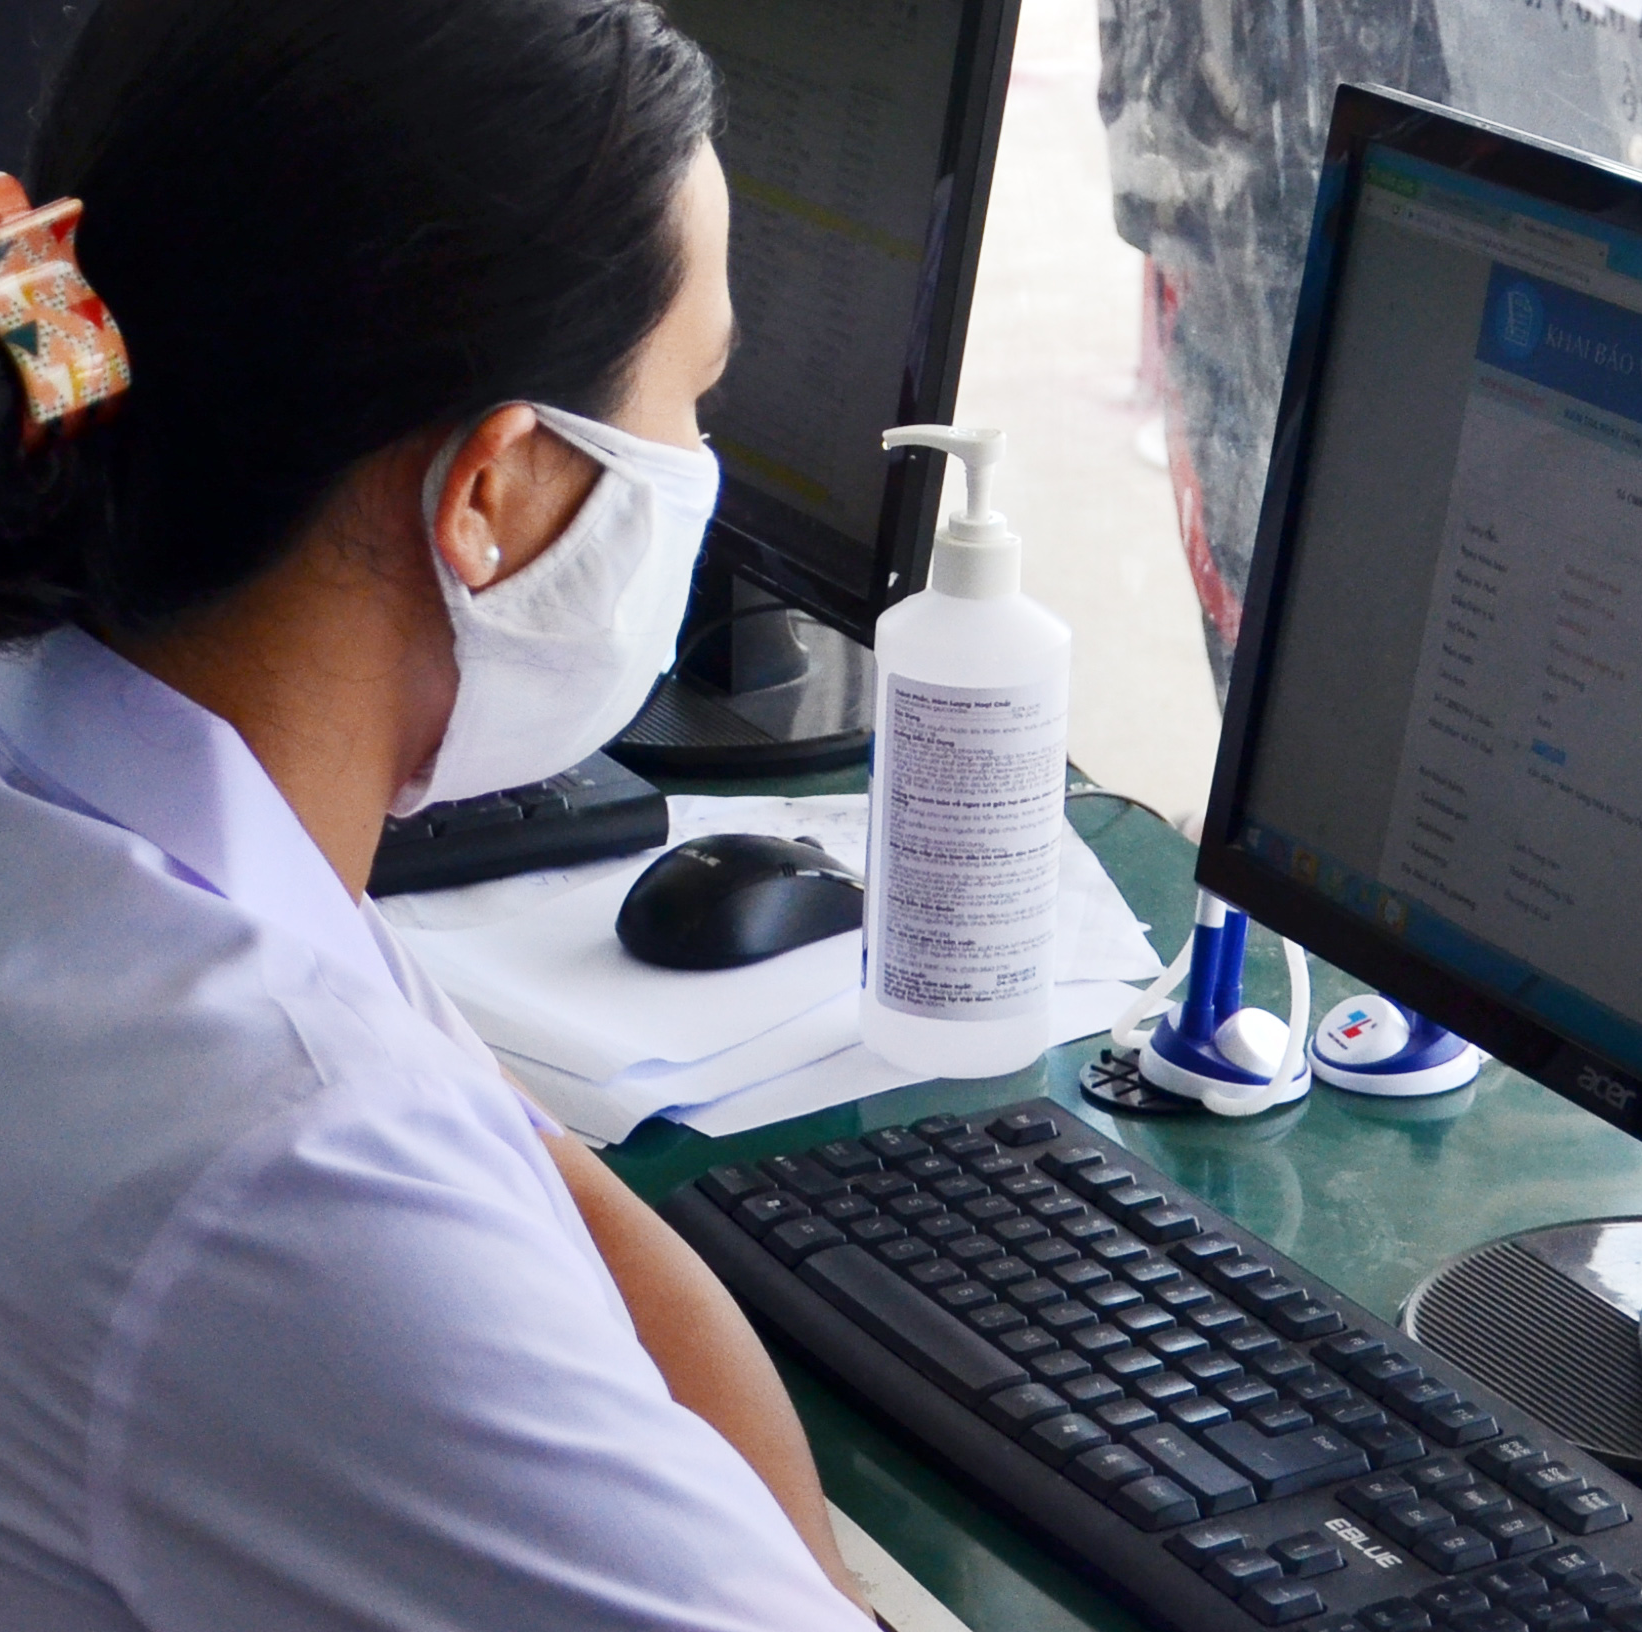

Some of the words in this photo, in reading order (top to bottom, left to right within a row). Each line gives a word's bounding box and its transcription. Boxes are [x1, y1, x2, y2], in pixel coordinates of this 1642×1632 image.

[1544, 322, 1593, 362] KHAI
[1593, 335, 1638, 379] BÁO
[1578, 1065, 1637, 1111] acer
[1324, 1517, 1403, 1569] EBLUE
